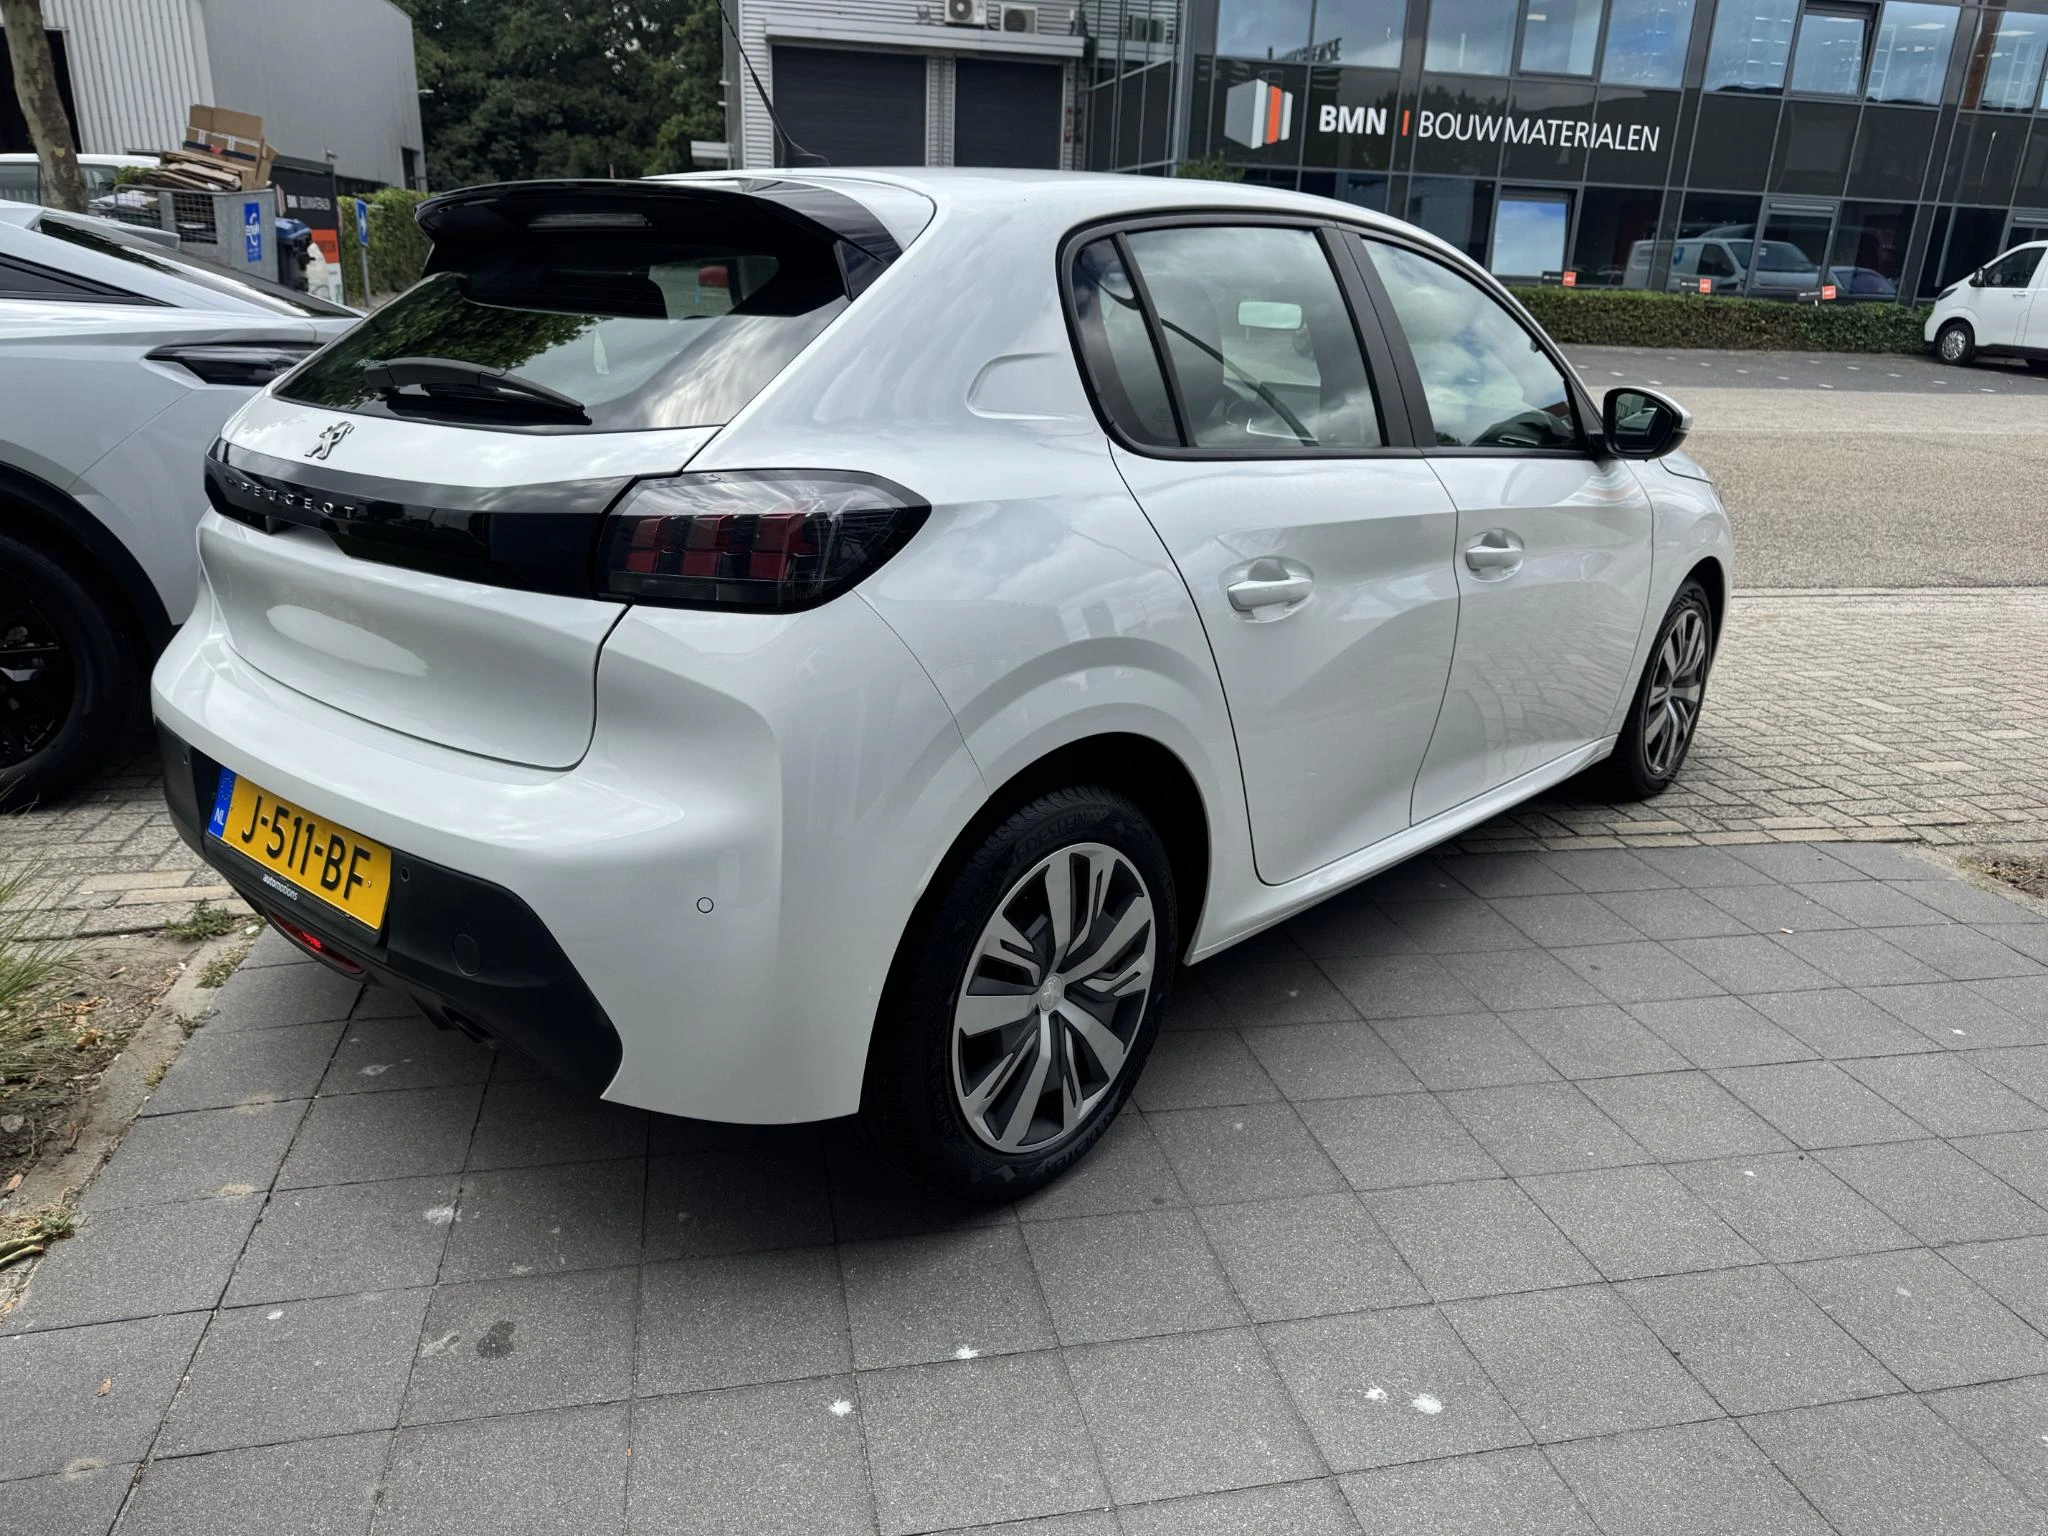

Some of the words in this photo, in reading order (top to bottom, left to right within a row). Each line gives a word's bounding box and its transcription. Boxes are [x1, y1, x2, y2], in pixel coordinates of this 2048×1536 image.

[1318, 104, 1388, 136] BMN
[1418, 110, 1660, 152] BOUWMATERIALEN
[240, 481, 356, 519] PEUGEOT
[213, 807, 225, 827] NL
[241, 795, 372, 901] J-511-BF
